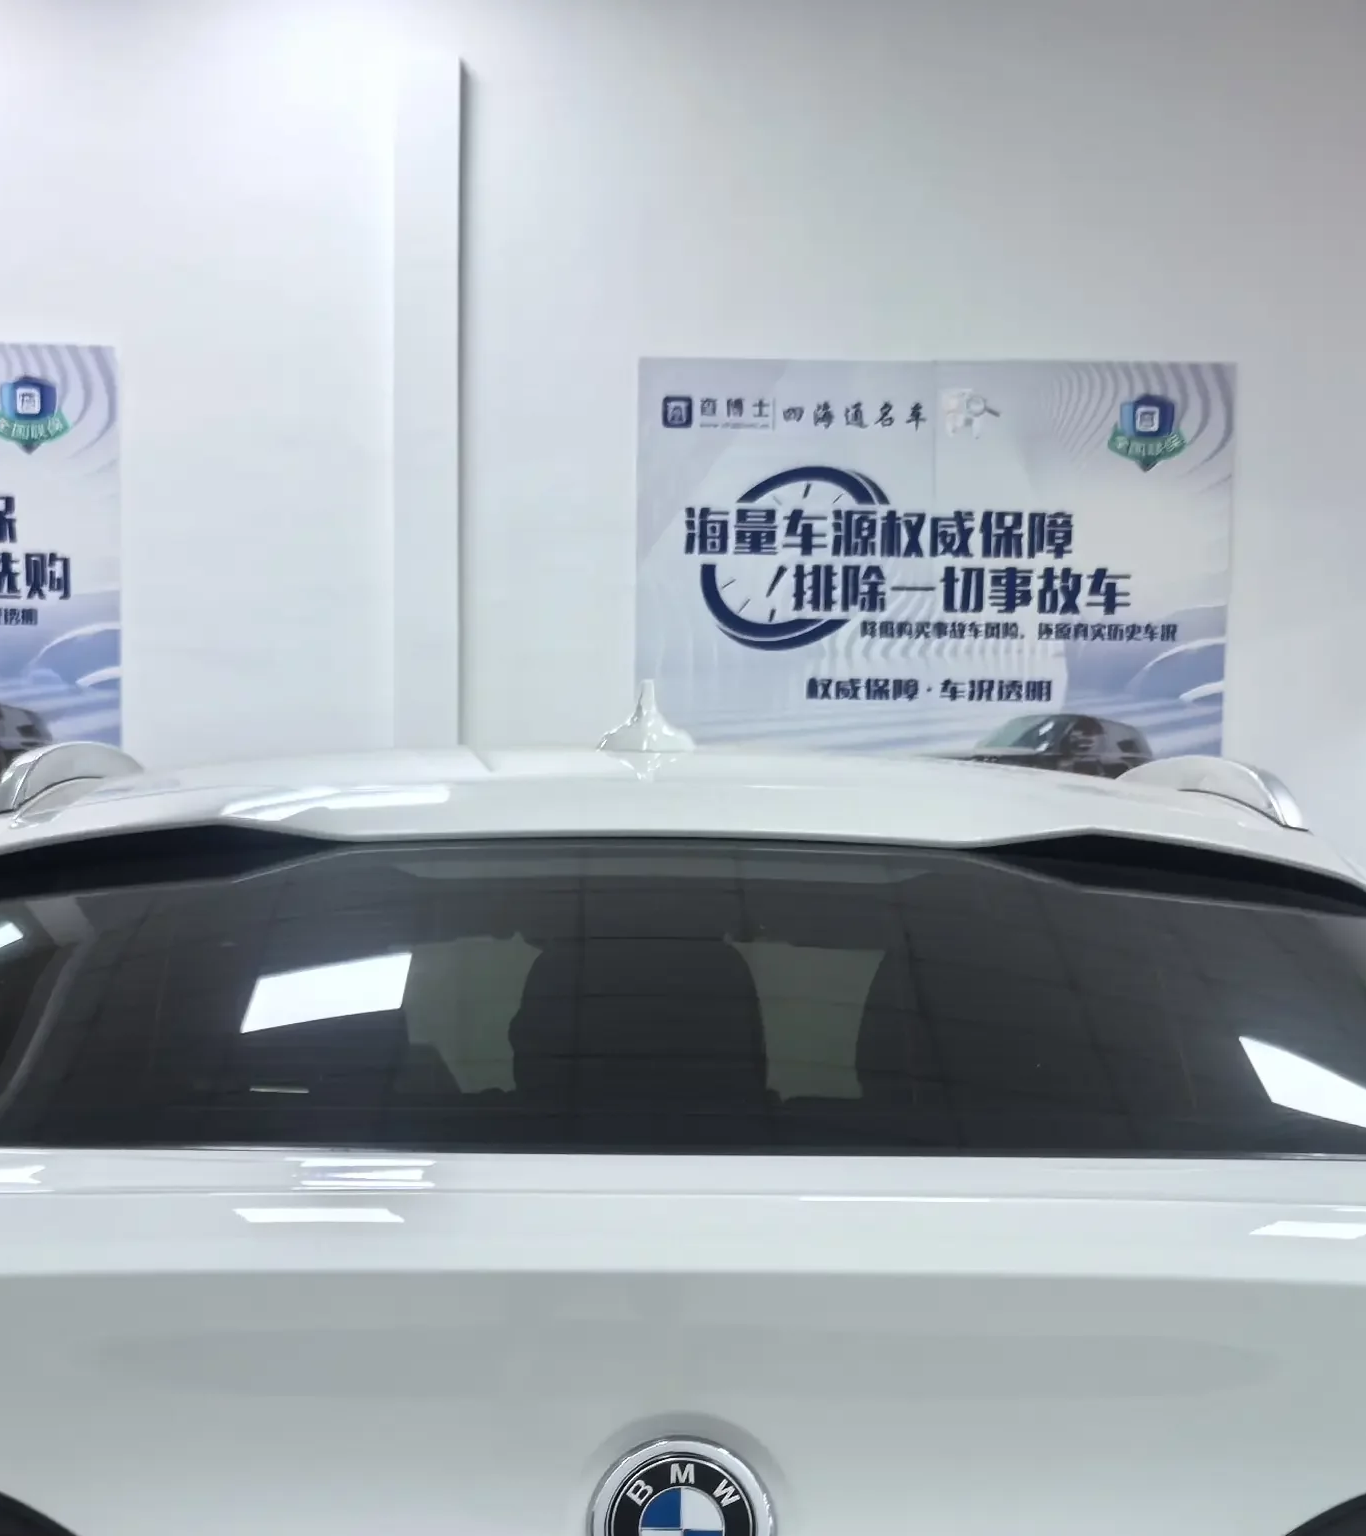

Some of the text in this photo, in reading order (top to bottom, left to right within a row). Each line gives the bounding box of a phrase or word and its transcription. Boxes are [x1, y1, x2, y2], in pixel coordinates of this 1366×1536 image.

[782, 400, 927, 432] 四海通名车
[683, 506, 1074, 559] 海量车源权威保障
[792, 563, 1133, 616] 排除一切事故车
[625, 1462, 742, 1508] BMW
